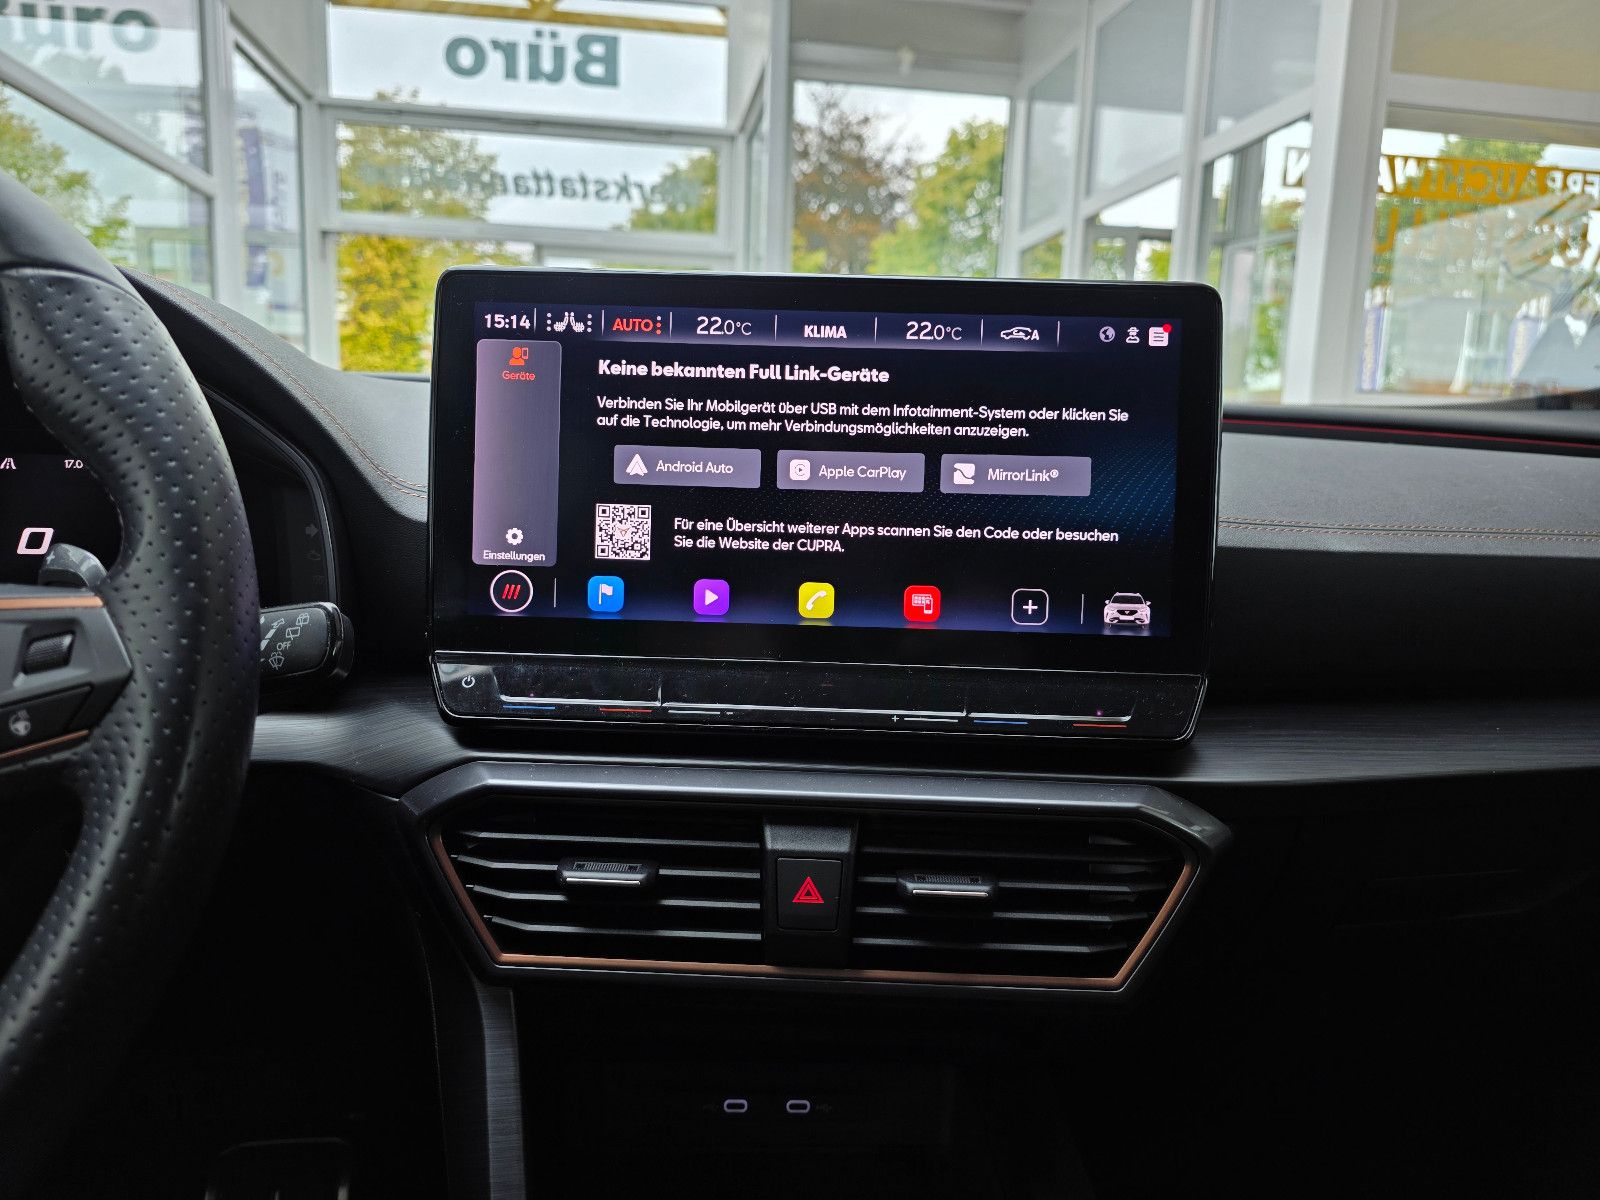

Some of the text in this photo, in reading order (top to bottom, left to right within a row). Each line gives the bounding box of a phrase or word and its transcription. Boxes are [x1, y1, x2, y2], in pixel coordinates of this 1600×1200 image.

[484, 313, 531, 330] 15:14
[612, 318, 654, 332] AUTO
[803, 325, 848, 340] KLIMA
[501, 369, 536, 381] Geräte
[598, 359, 890, 383] Keine bekannten Full Link-Geräte
[596, 395, 1129, 422] Verbinden Sie Ihr Mobilgerät über USB mit dem Infotainment-System oder klicken Sie
[596, 413, 1030, 440] auf die Technologie, um mehr Verbindungsmöglichkeiten anzuzeigen.
[64, 459, 84, 469] 17.0
[655, 459, 734, 475] Android Auto
[818, 464, 907, 481] Apple CarPlay
[674, 516, 1119, 542] Für eine Übersicht weiterer Apps scannen Sie den Code oder besuchen
[16, 527, 54, 555] 0
[673, 534, 845, 553] Sie die Website der CUPRA.
[482, 549, 546, 563] Einstellungen
[276, 641, 292, 651] OFF
